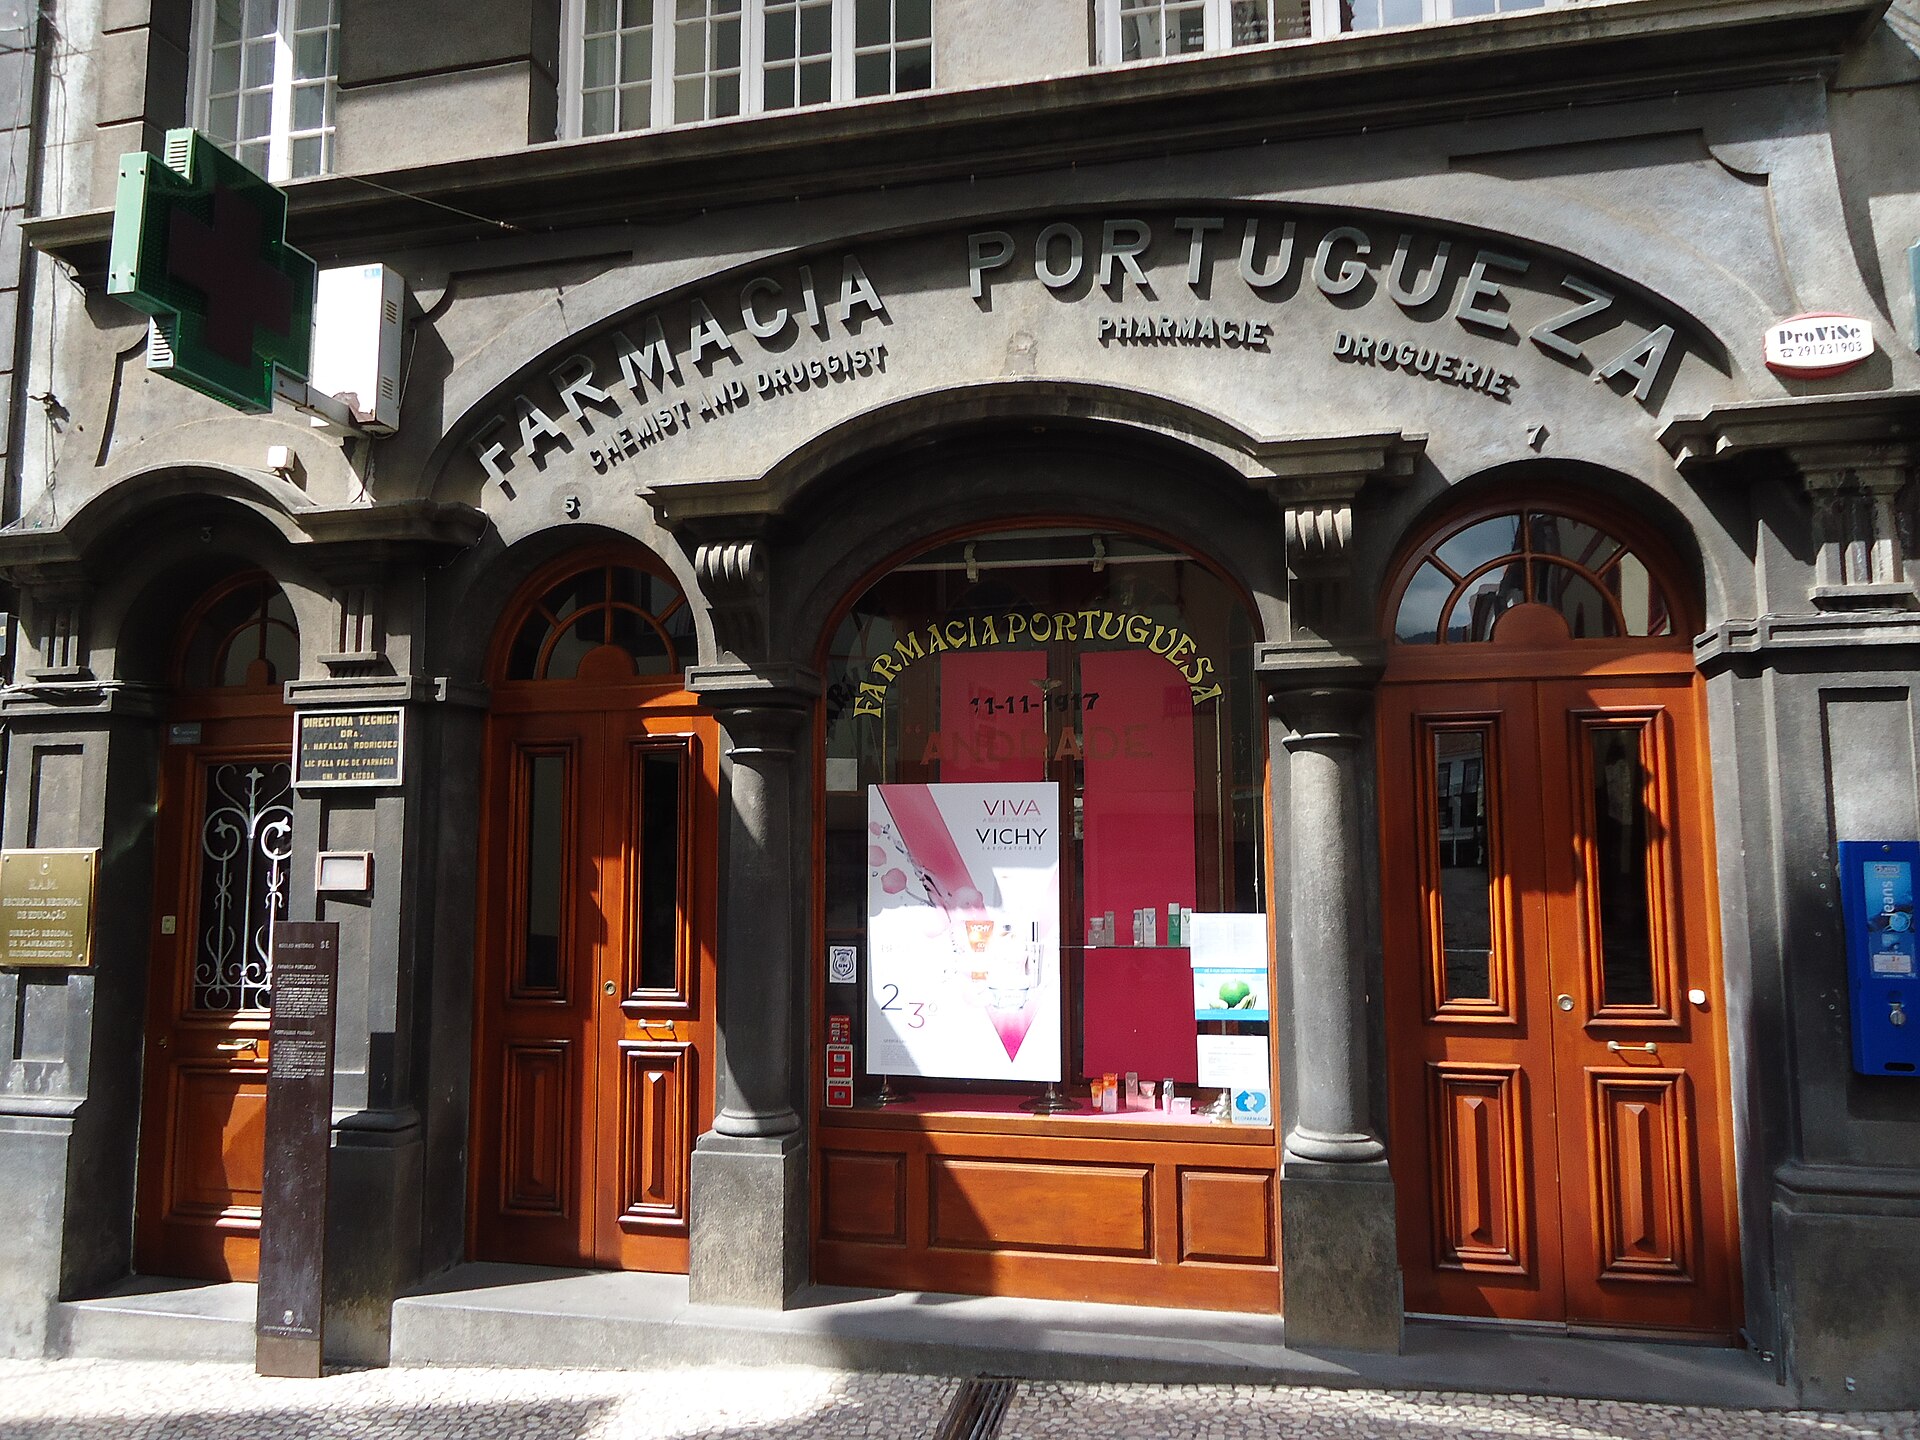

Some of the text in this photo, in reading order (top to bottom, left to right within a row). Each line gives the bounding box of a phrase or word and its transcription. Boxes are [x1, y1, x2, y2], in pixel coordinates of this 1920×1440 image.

[1098, 316, 1270, 347] PHARMACIE
[1779, 324, 1861, 345] ProViSe
[466, 216, 1675, 487] FARMACIA PORTUGUEZA
[1798, 341, 1863, 357] 291231903
[1333, 330, 1514, 396] DROGUERIE
[588, 343, 884, 468] CHEMIST AND DRUGGIST
[1526, 423, 1544, 446] 7
[563, 494, 578, 514] 5
[1002, 608, 1223, 707] PORTUGUESA
[303, 716, 354, 728] DIRECTORA
[353, 740, 399, 749] RODRIGUES
[983, 799, 1041, 816] VIVA
[975, 828, 1048, 845] VICHY
